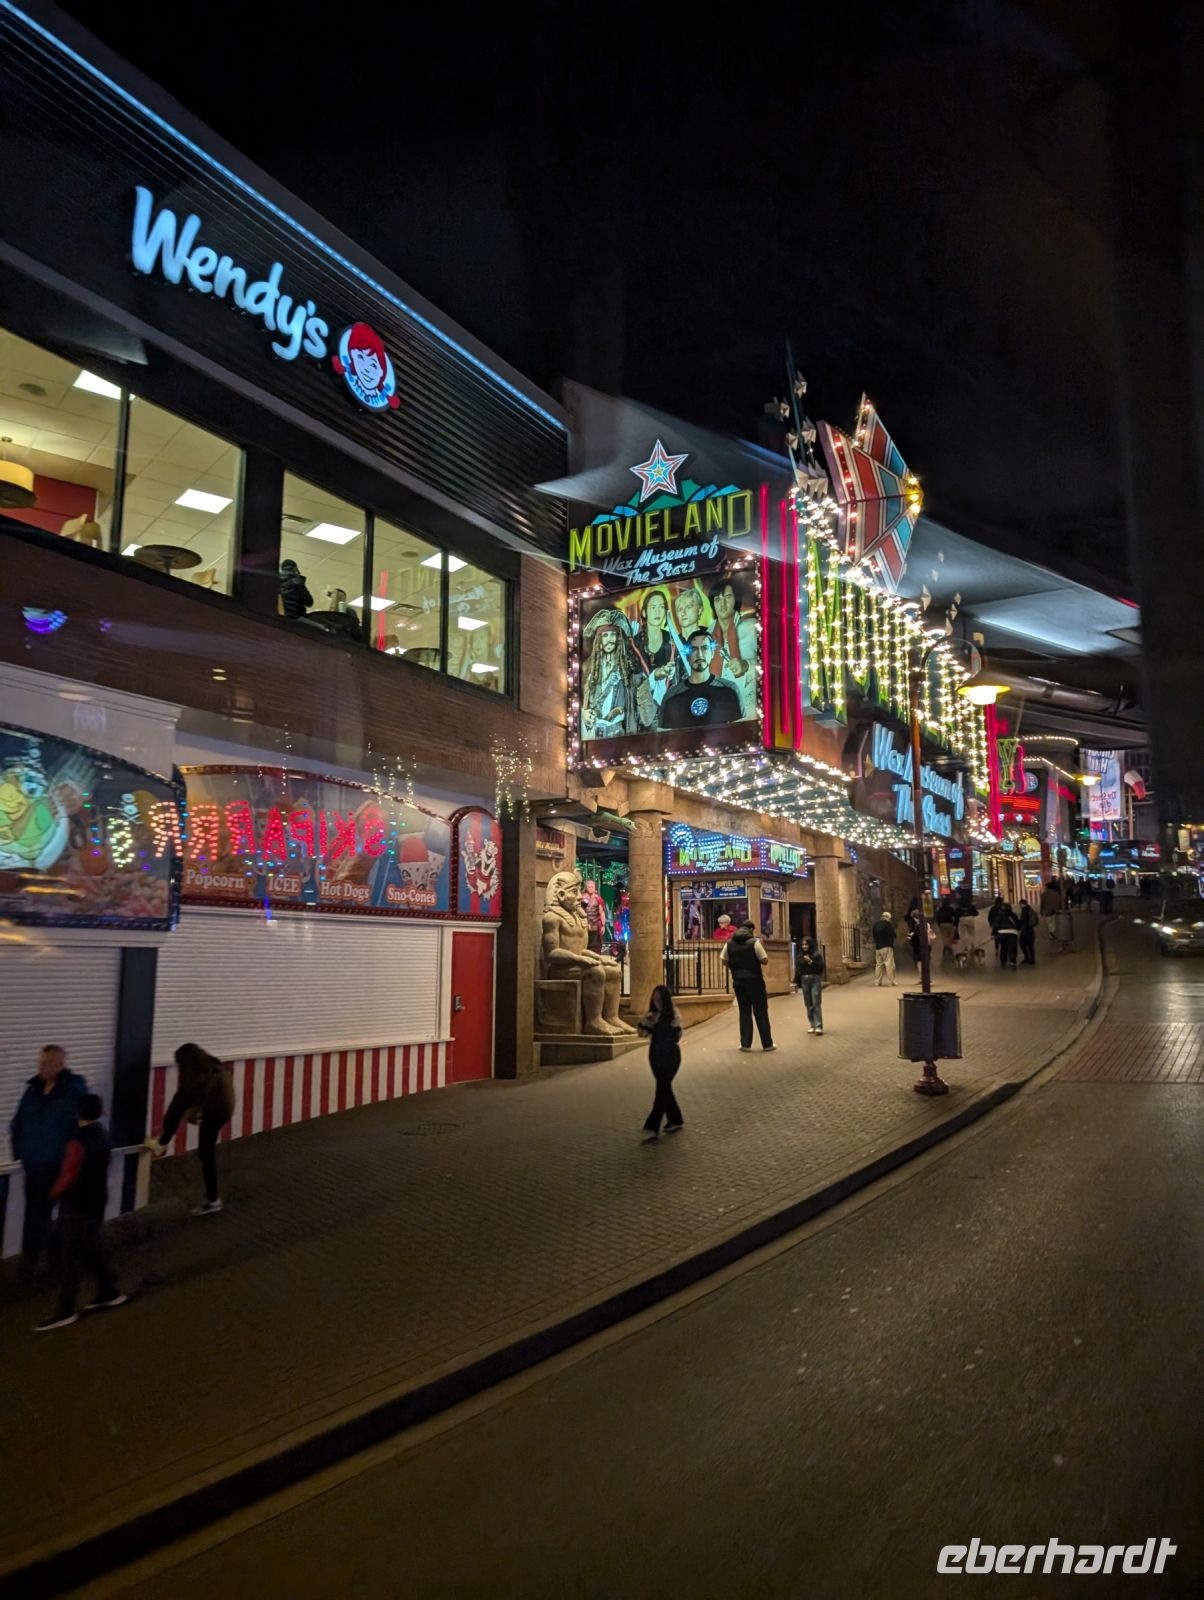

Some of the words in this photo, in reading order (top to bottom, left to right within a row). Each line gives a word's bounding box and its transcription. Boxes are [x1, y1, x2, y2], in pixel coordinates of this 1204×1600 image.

[132, 186, 328, 360] Wendy's
[569, 489, 753, 573] MOVIELAND
[602, 556, 633, 575] Wax
[634, 543, 698, 568] Museum
[700, 535, 719, 559] of
[625, 568, 650, 587] The
[651, 559, 696, 582] Stars
[891, 784, 914, 824] Th
[186, 868, 245, 890] Popcorn
[268, 877, 299, 894] ICEE
[320, 881, 344, 897] Hot
[344, 884, 370, 901] Dogs
[387, 889, 437, 904] Sno-Cones
